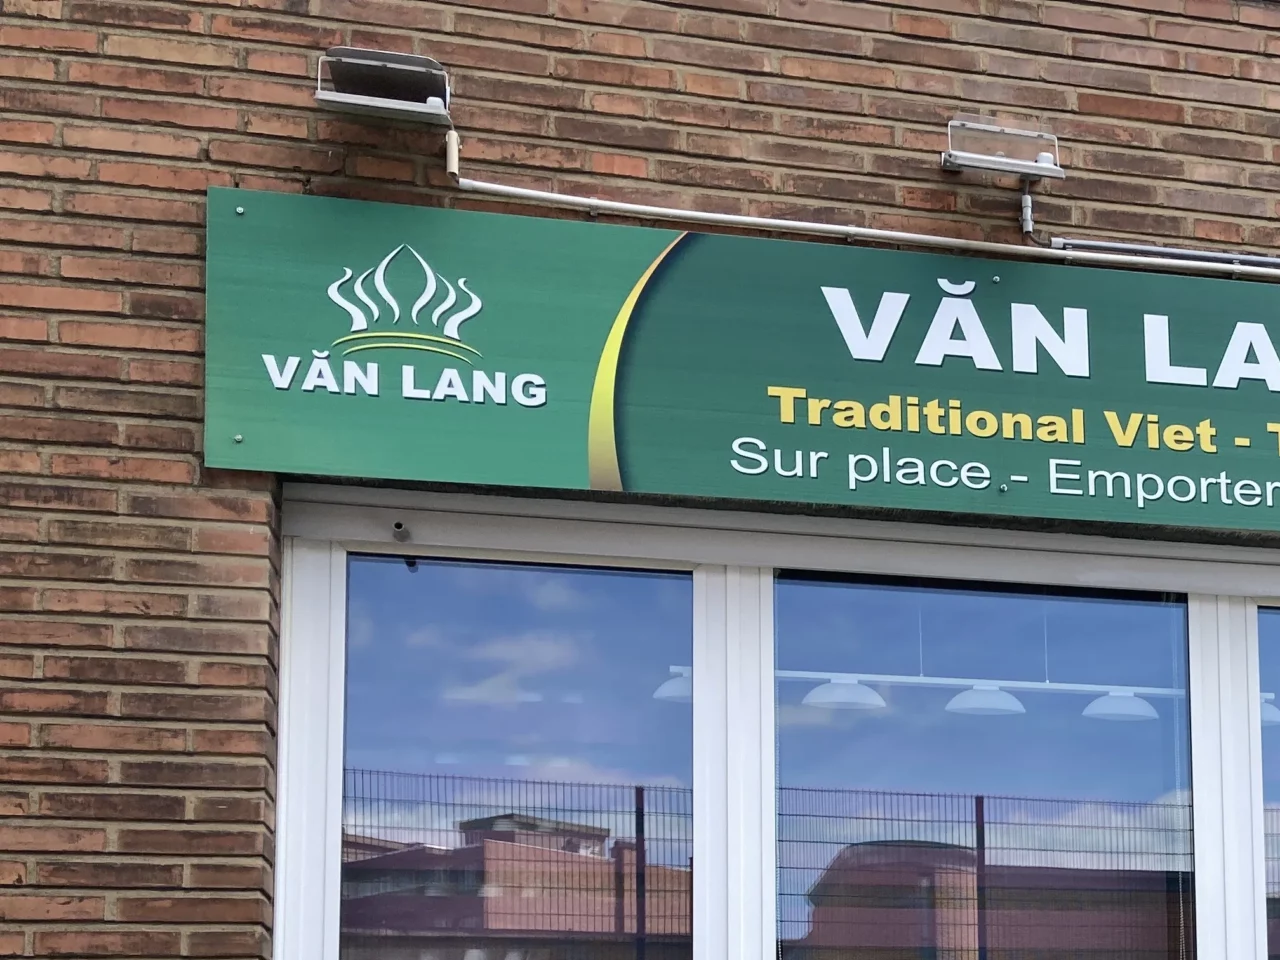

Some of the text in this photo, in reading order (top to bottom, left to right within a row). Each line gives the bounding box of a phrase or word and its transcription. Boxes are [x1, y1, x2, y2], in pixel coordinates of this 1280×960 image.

[820, 278, 1089, 376] VĂN
[261, 349, 547, 407] VĂN LANG
[767, 386, 1085, 443] Traditional
[1105, 411, 1218, 453] Viet
[730, 437, 829, 479] Sur
[848, 446, 991, 491] place
